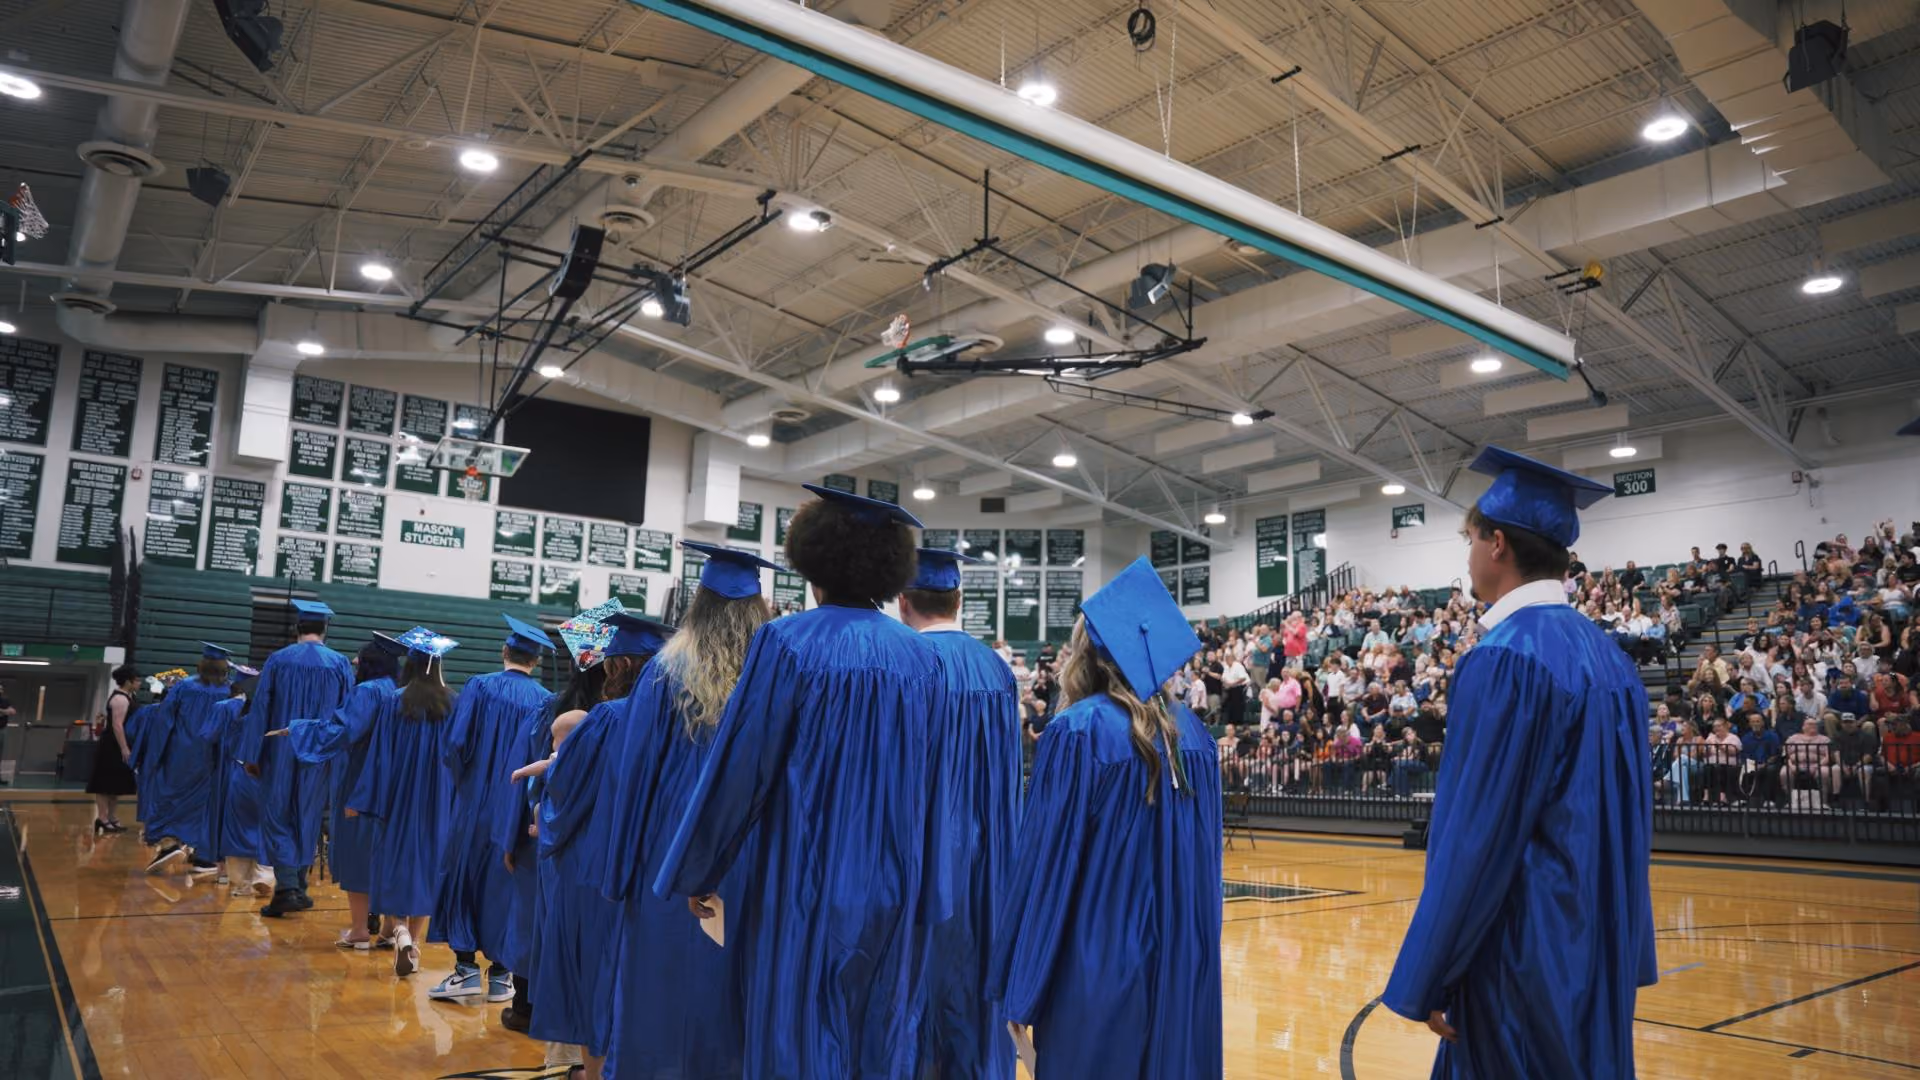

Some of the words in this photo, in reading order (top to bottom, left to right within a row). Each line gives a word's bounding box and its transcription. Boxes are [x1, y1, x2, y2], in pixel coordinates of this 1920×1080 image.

[1616, 471, 1653, 483] SECTION
[1624, 480, 1648, 494] 300
[413, 522, 454, 536] MASON
[404, 532, 461, 547] STUDENTS
